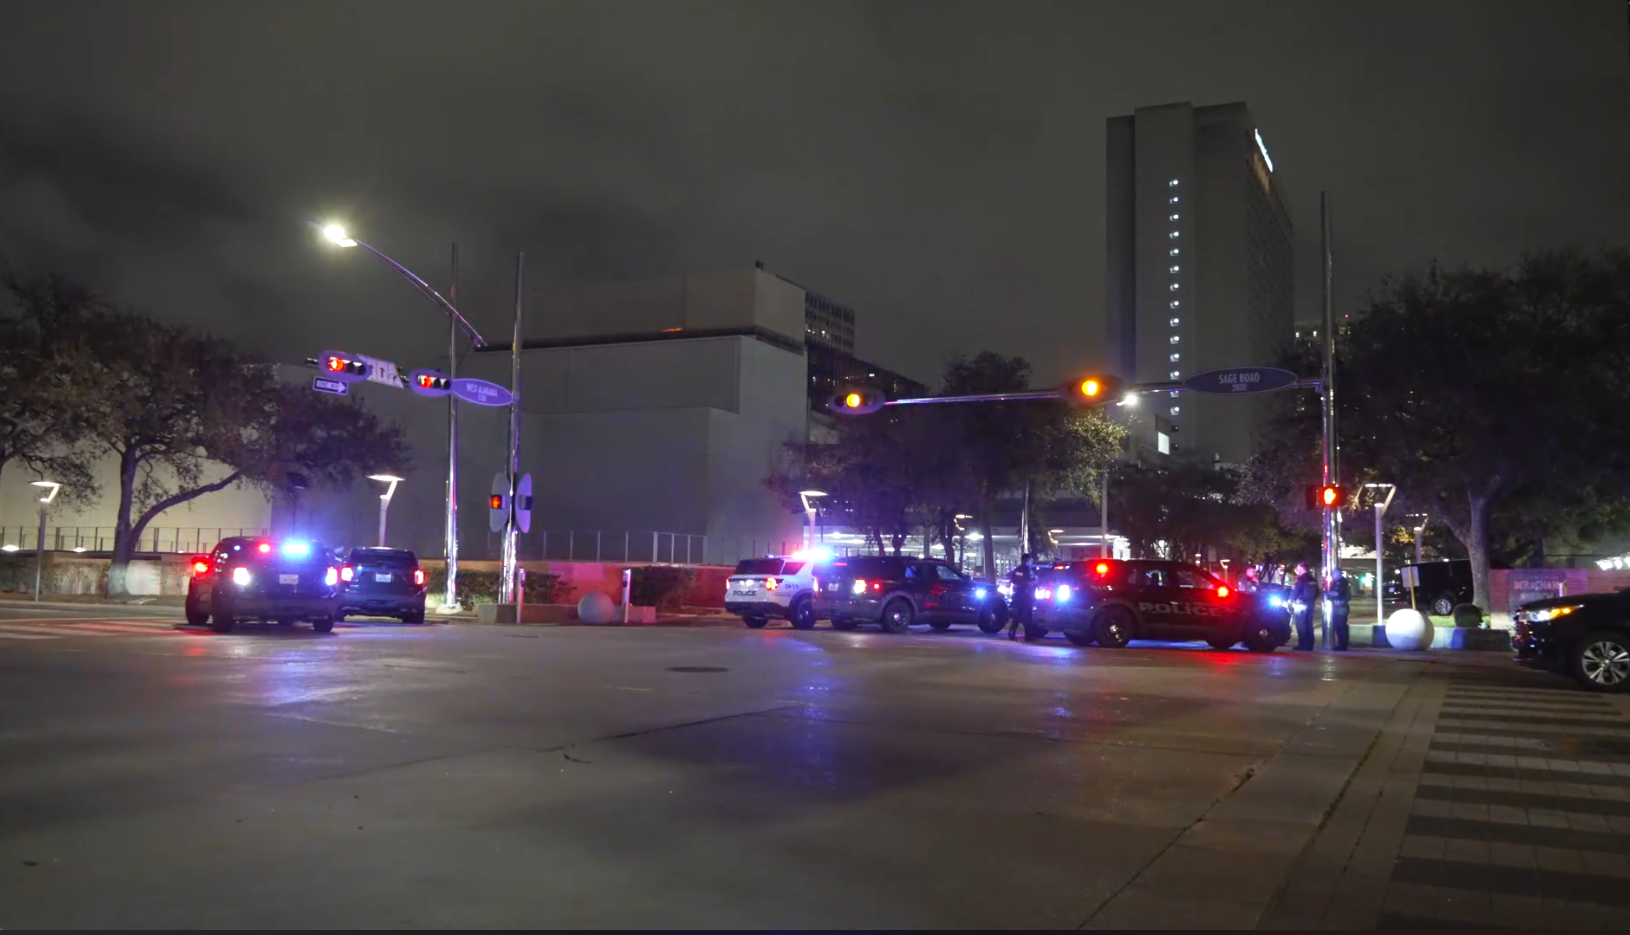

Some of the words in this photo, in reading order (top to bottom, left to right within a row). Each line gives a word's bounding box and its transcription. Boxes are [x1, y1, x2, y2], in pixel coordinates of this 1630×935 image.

[1219, 373, 1237, 384] SAGE
[1239, 372, 1260, 383] ROAD
[1138, 601, 1224, 617] POLICE
